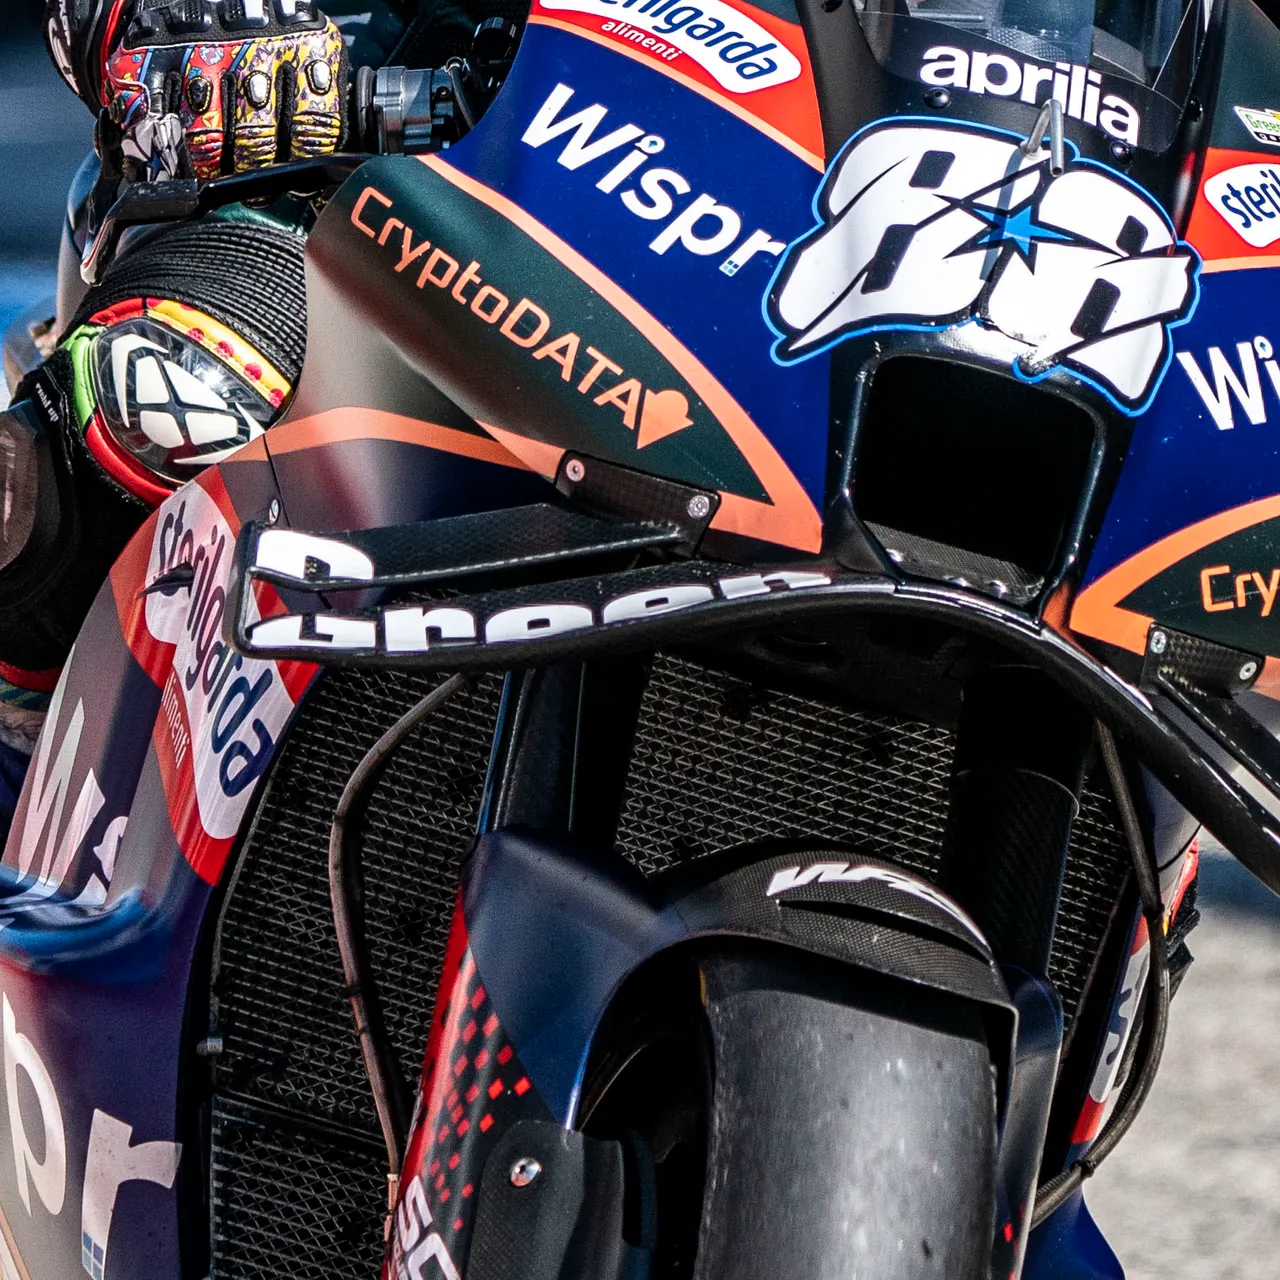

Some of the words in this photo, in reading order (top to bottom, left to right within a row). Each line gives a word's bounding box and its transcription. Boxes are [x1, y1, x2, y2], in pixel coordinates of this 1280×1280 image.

[600, 19, 684, 61] alimenti
[920, 45, 1141, 147] aprilia
[521, 82, 787, 277] Wispr
[350, 185, 649, 431] CryptoDATA
[778, 127, 1191, 400] 88
[162, 668, 191, 770] limenti
